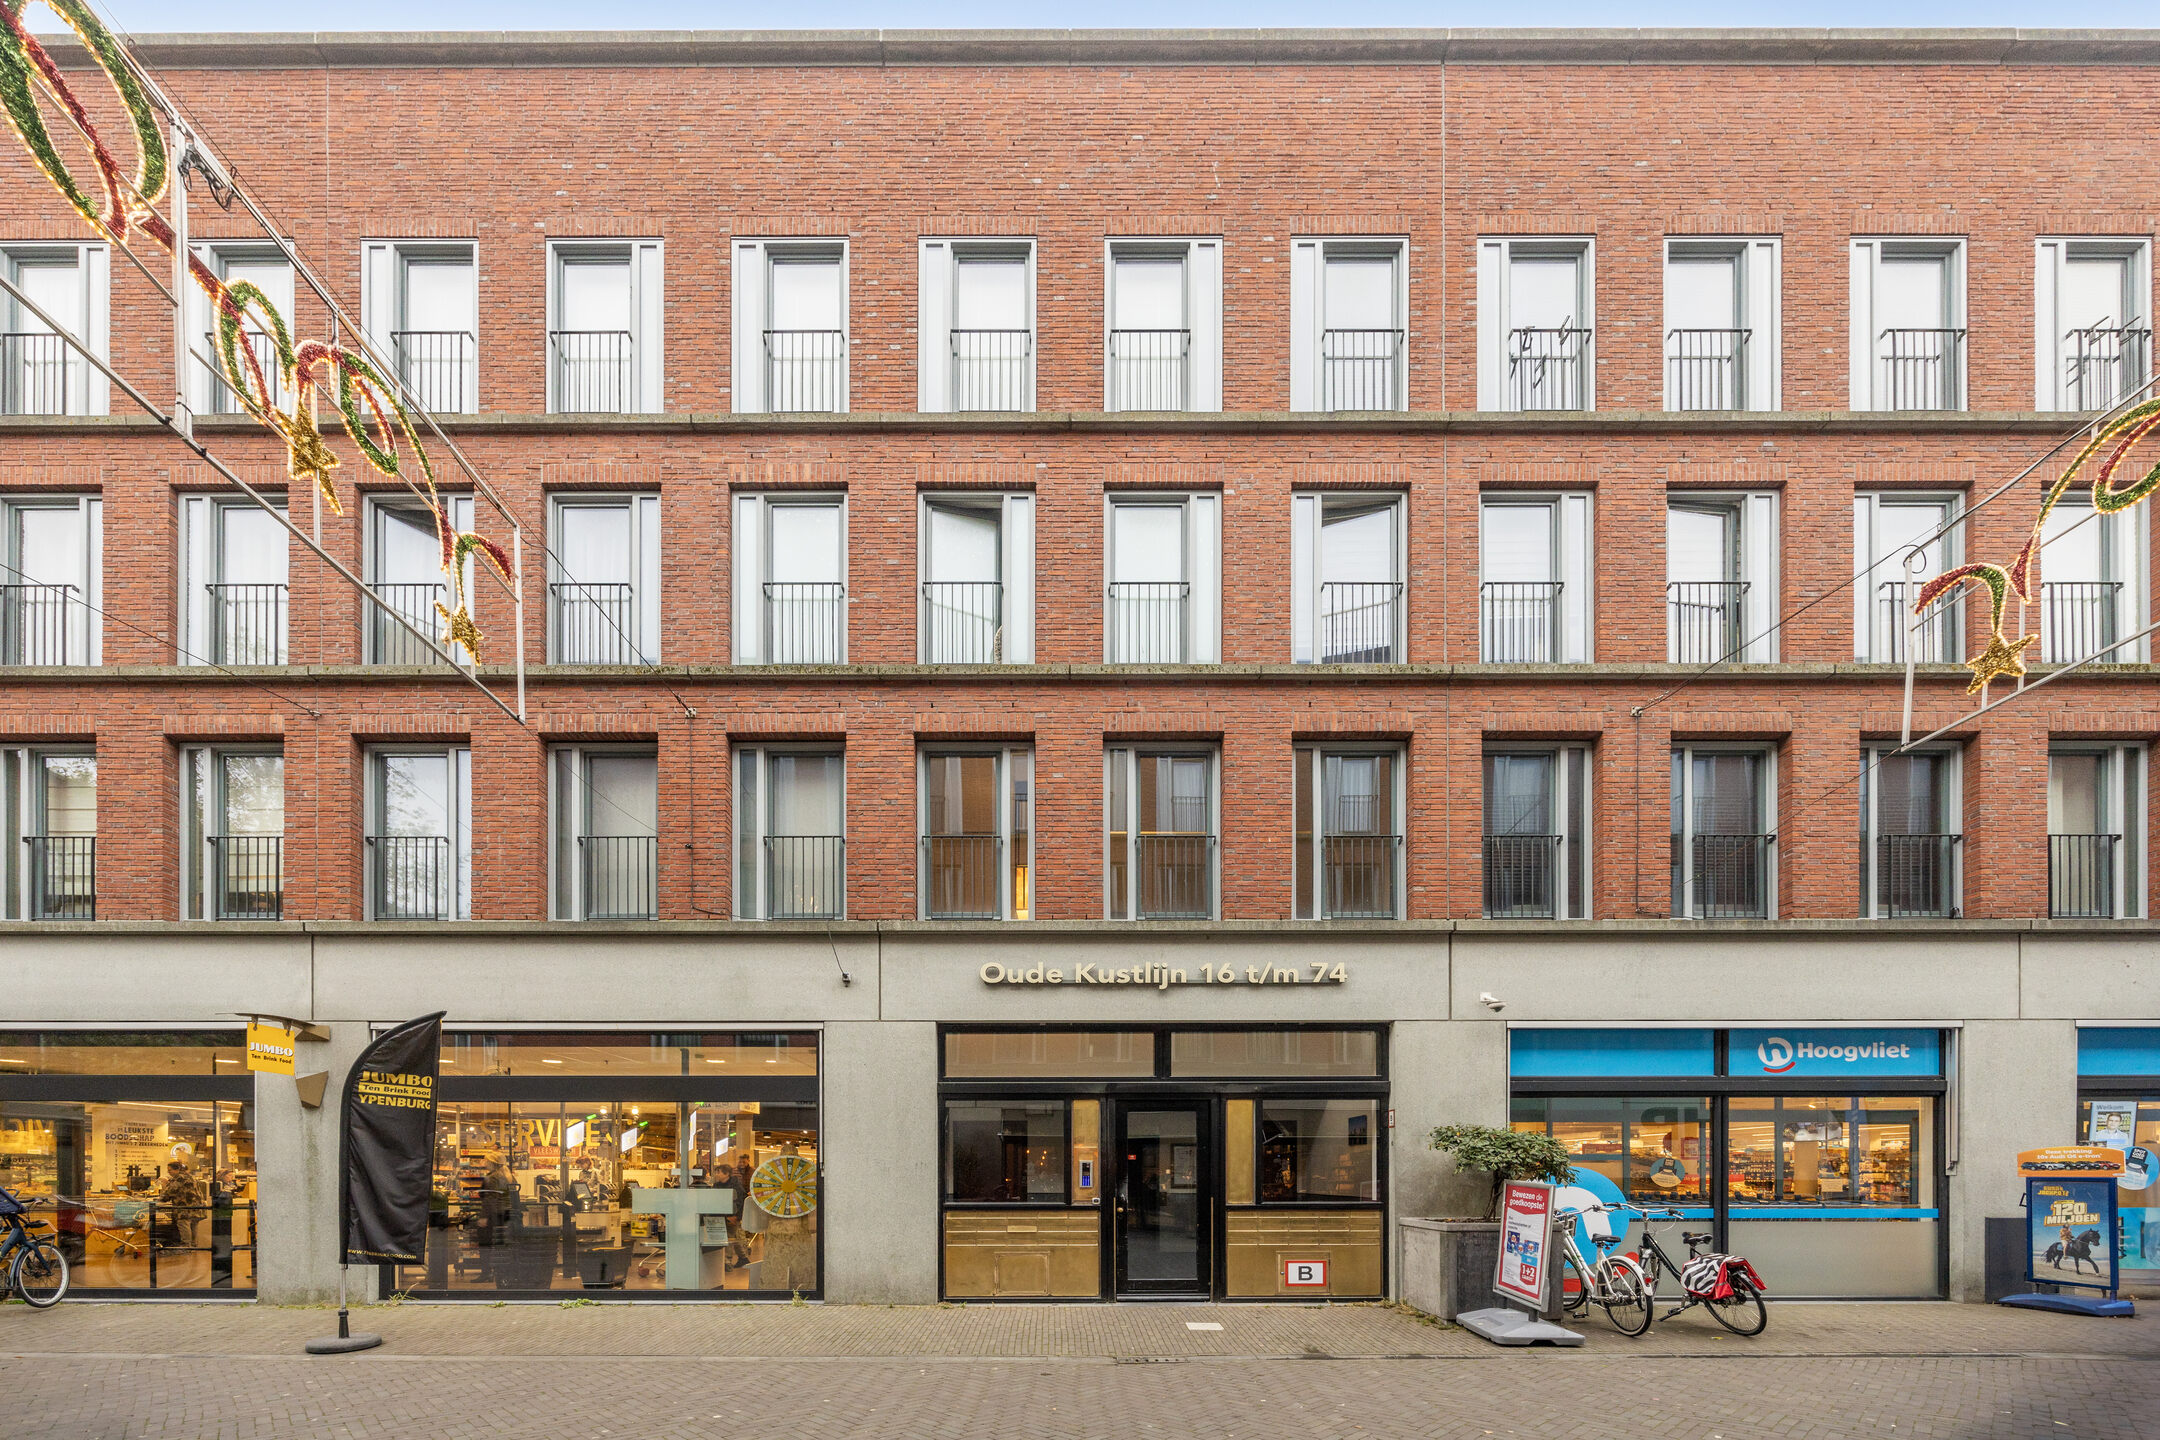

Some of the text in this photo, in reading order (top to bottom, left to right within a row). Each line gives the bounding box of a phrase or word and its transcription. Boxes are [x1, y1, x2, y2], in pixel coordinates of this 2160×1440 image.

[980, 961, 1348, 990] Oude Kustlijn 16 t/m 74
[249, 1042, 294, 1057] JUMBO
[1797, 1041, 1910, 1062] Hoogvliet
[263, 1055, 278, 1063] Brink
[280, 1057, 292, 1065] Food
[360, 1070, 432, 1087] JUMBO
[363, 1084, 380, 1092] Ten
[384, 1085, 409, 1094] Brink
[358, 1093, 431, 1110] YPENBURG
[124, 1127, 155, 1135] LEUKSTE
[1512, 1190, 1535, 1200] Bewezen
[1509, 1199, 1544, 1210] goedkoopste!
[2054, 1202, 2087, 1216] 120
[2046, 1213, 2099, 1225] MILJOEN
[1298, 1265, 1313, 1281] B
[1522, 1264, 1535, 1277] 1+2
